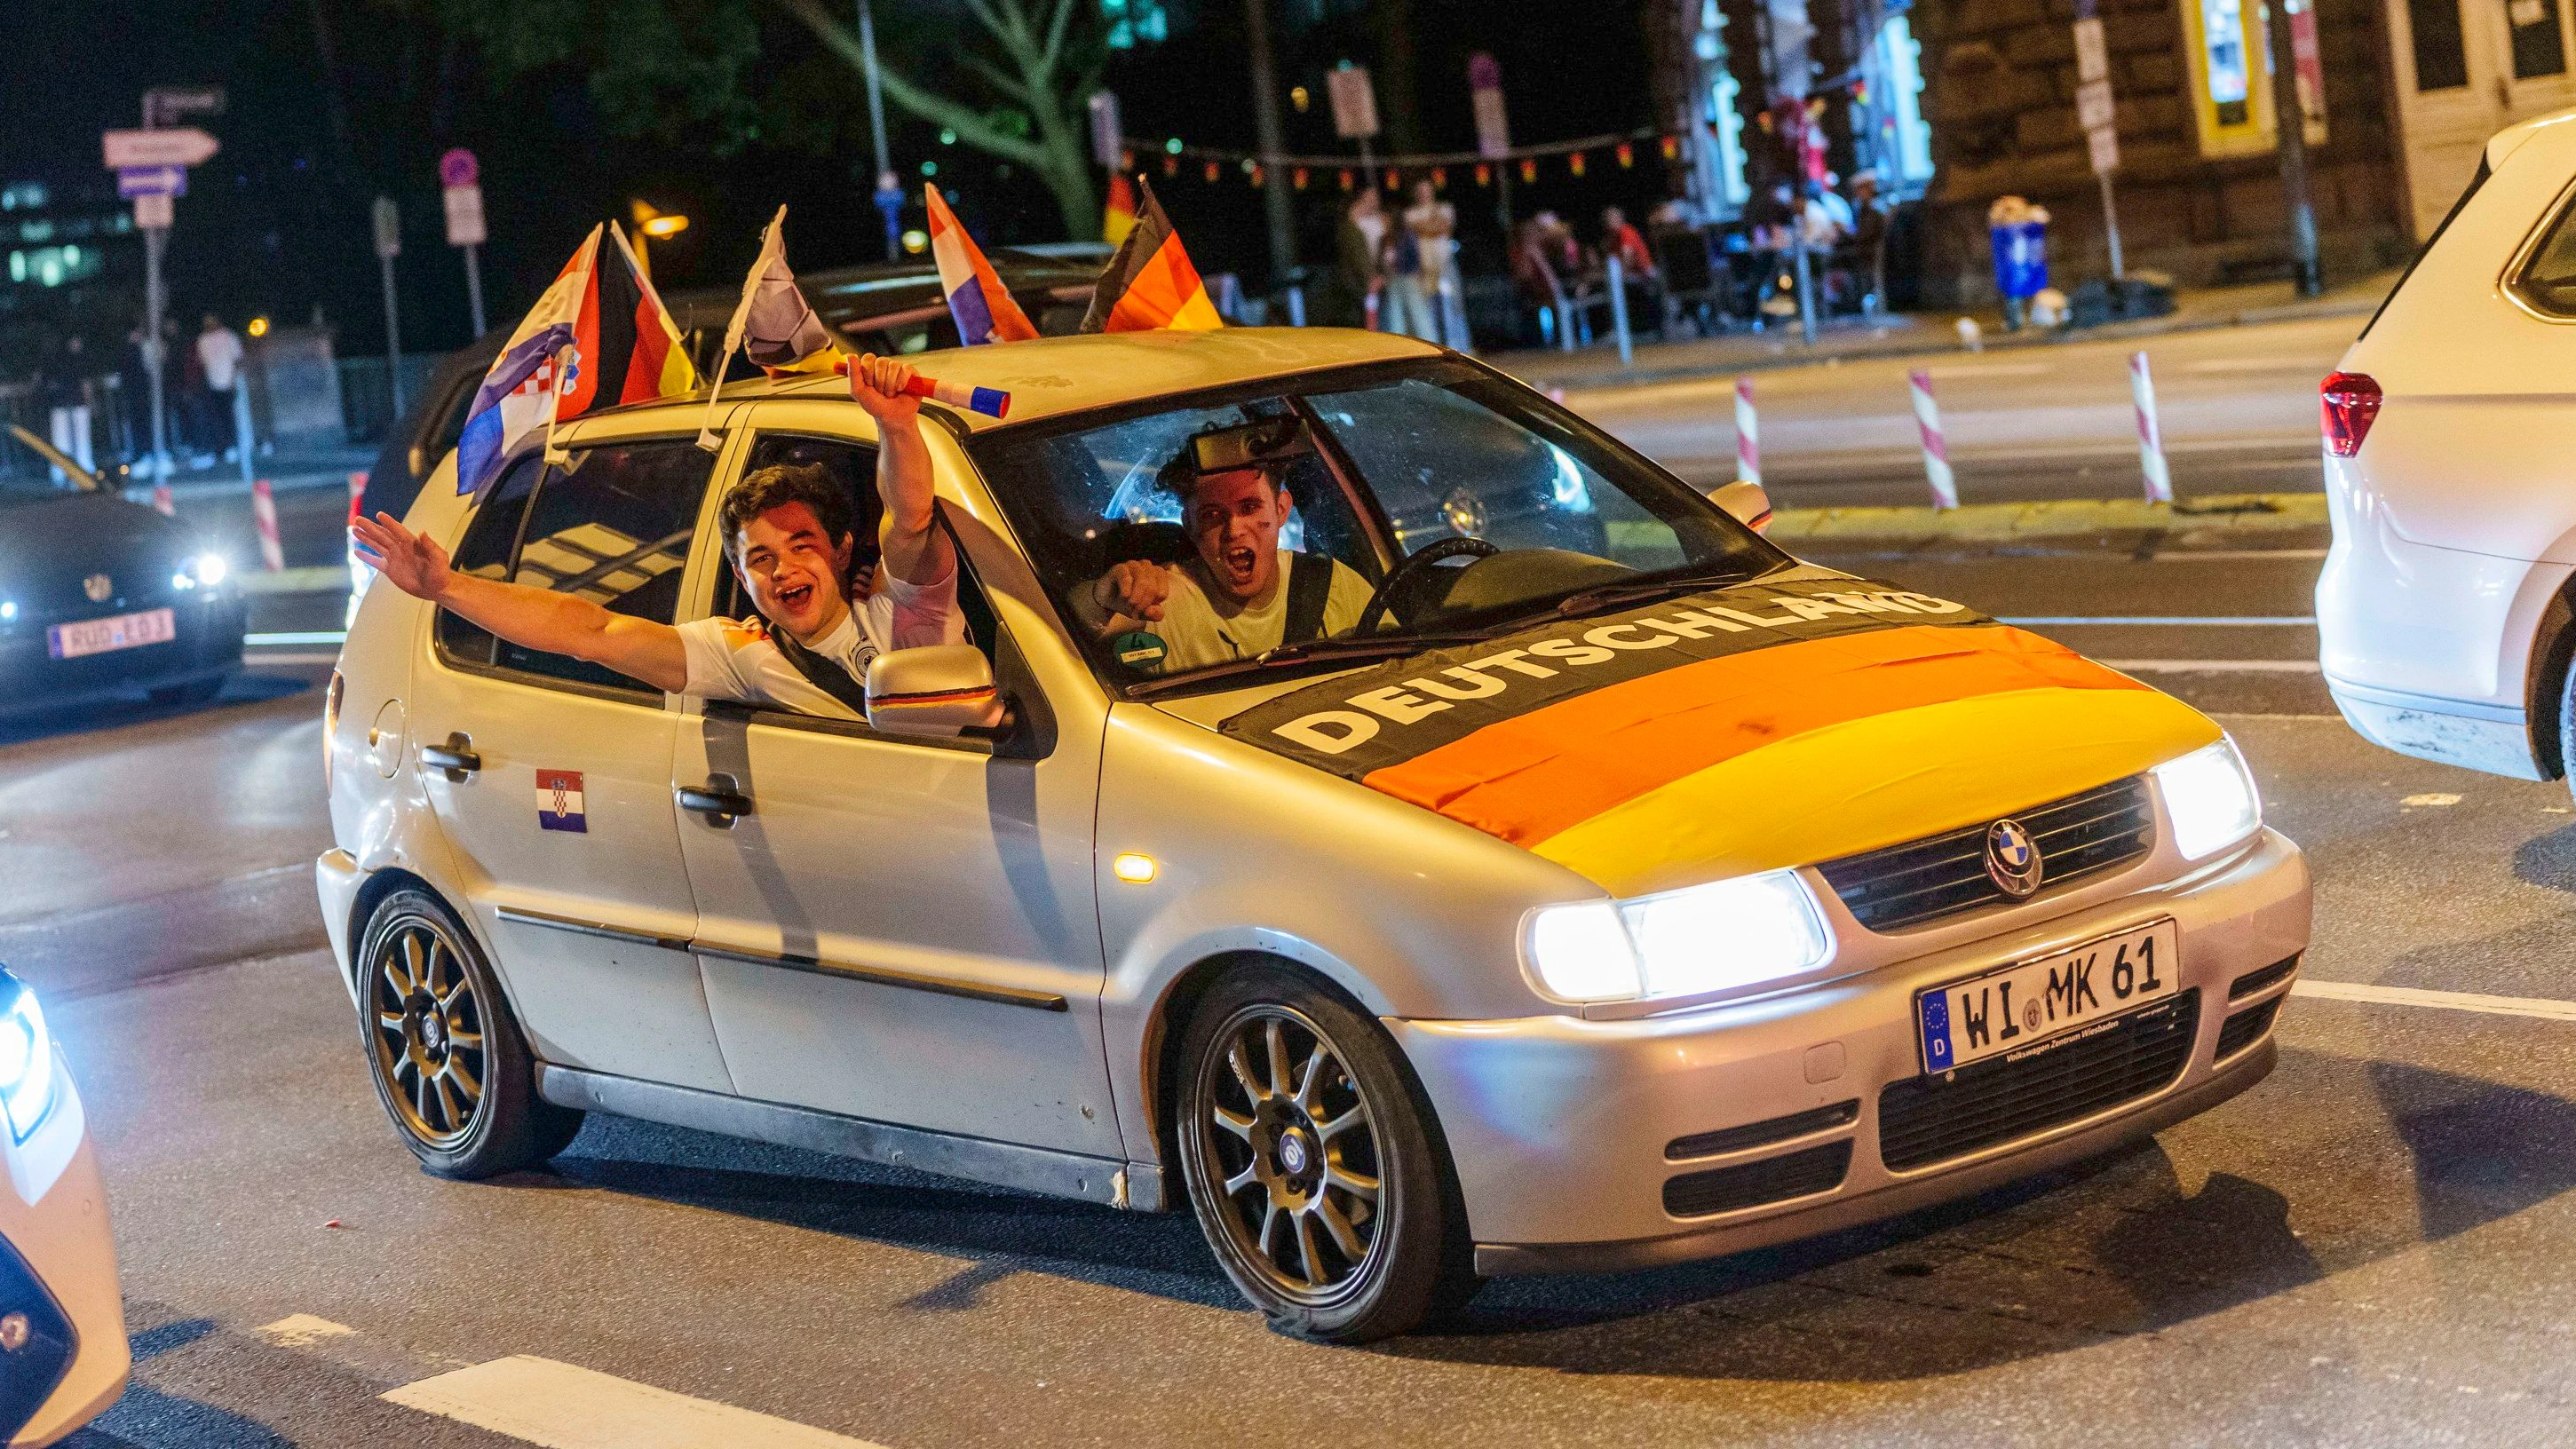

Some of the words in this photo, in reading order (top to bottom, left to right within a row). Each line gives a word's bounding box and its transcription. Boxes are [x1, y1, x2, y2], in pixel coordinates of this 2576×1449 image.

[1271, 590, 1965, 755] DEUTSCHLAND
[1962, 980, 2020, 1049] WI
[2045, 952, 2099, 1021] MK
[2112, 935, 2161, 999] 61
[1933, 1038, 1946, 1056] D
[2007, 1042, 2050, 1063] Volkswagen
[2051, 1033, 2081, 1049] Zentrum
[2081, 1020, 2120, 1038] Wiesbaden
